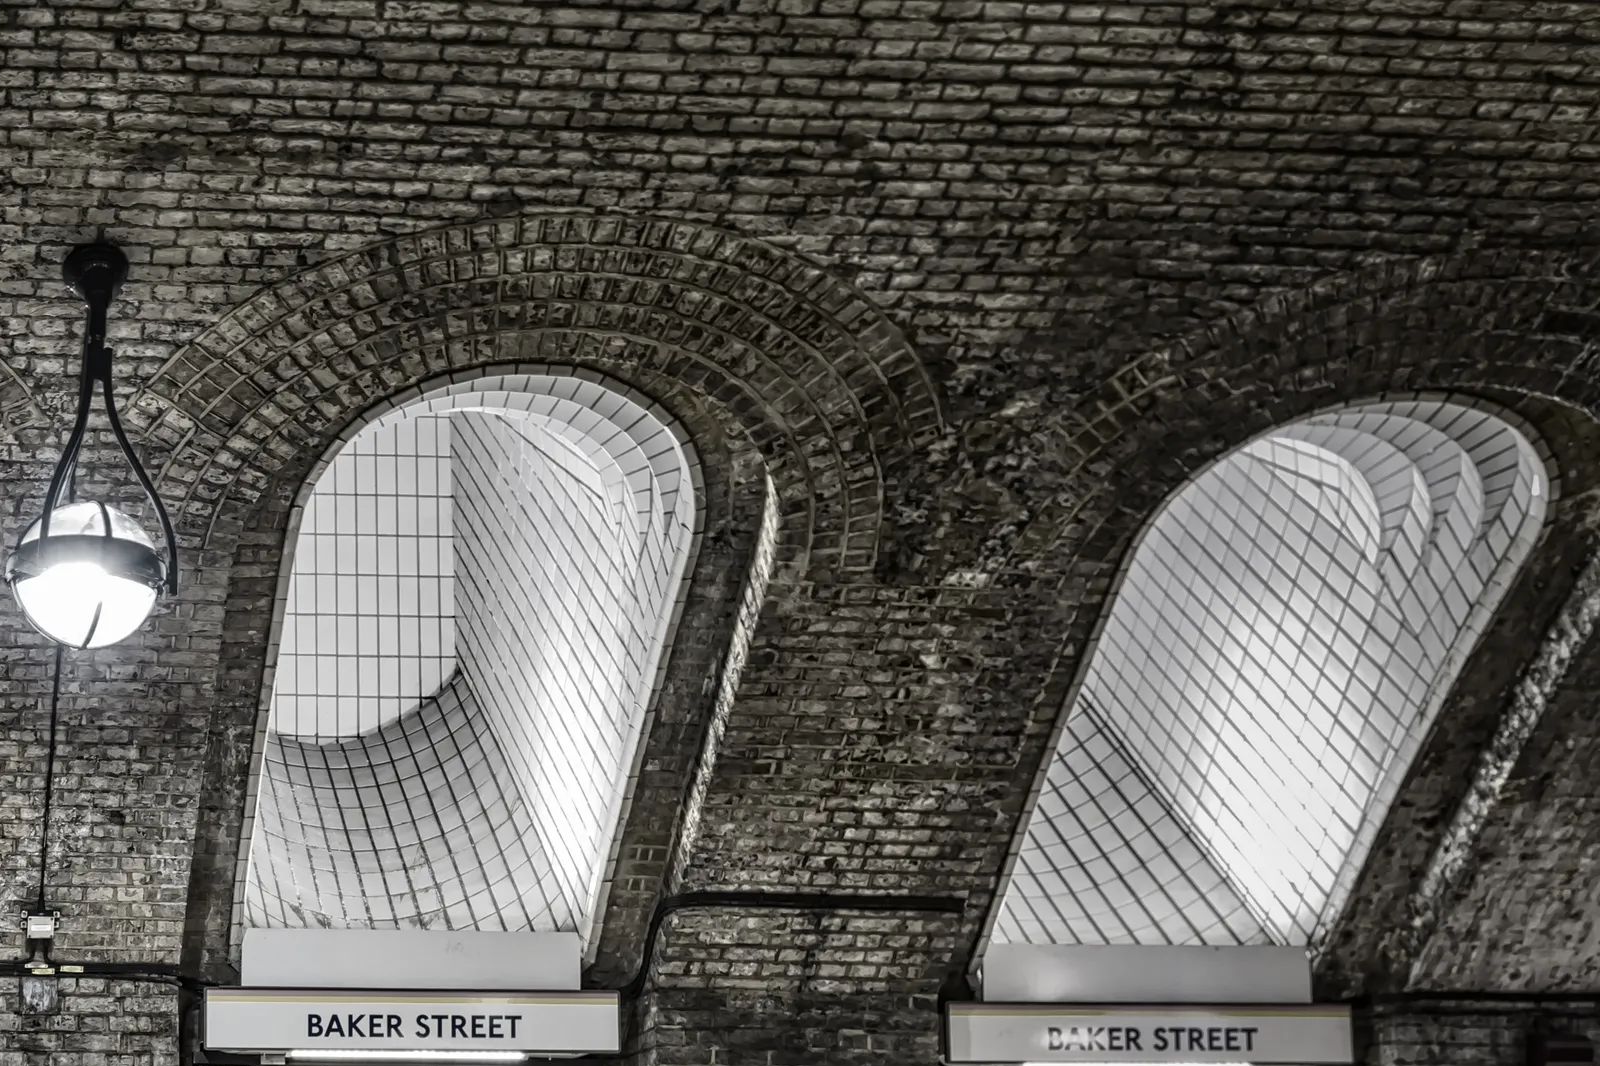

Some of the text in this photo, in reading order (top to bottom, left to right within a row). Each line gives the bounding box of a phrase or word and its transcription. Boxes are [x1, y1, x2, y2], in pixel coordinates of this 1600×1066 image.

[306, 1013, 522, 1039] BAKER STREET
[1047, 1026, 1259, 1052] BAKER STREET
